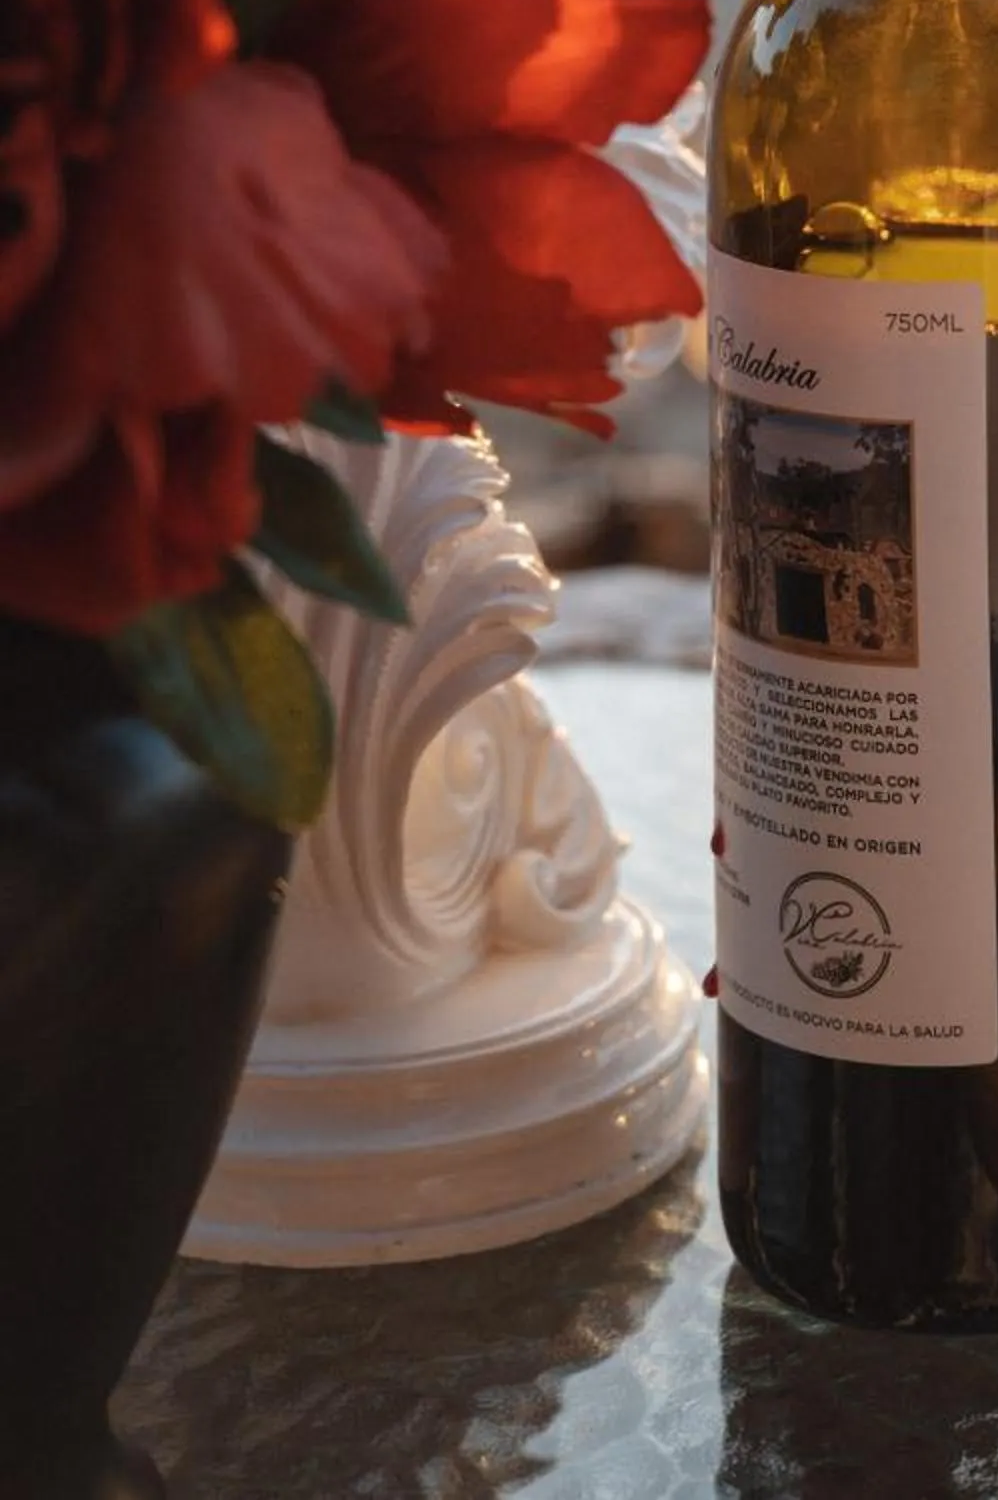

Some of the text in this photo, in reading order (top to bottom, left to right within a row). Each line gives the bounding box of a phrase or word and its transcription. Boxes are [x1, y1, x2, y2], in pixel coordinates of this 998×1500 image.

[885, 312, 965, 334] 750ML
[767, 689, 878, 720] SELECCIONAMOS
[889, 708, 919, 722] LAS
[797, 681, 883, 704] ACARICIADA
[886, 691, 919, 705] POR
[772, 723, 843, 750] MINUCIOSO
[850, 738, 919, 756] CUIDADO
[793, 712, 829, 731] PARA
[832, 721, 919, 739] HONRARLA.
[760, 752, 811, 779] NUESTRA
[814, 766, 883, 787] VENDIMIA
[887, 775, 920, 789] CON
[825, 785, 904, 805] COMPLEJO
[909, 791, 920, 805] Y
[734, 802, 921, 856] EMBOTELLADO EN ORIGEN
[792, 1008, 843, 1031] NOCIVO
[847, 1020, 885, 1036] PARA
[889, 1023, 909, 1038] LA
[913, 1025, 964, 1039] SALUD
